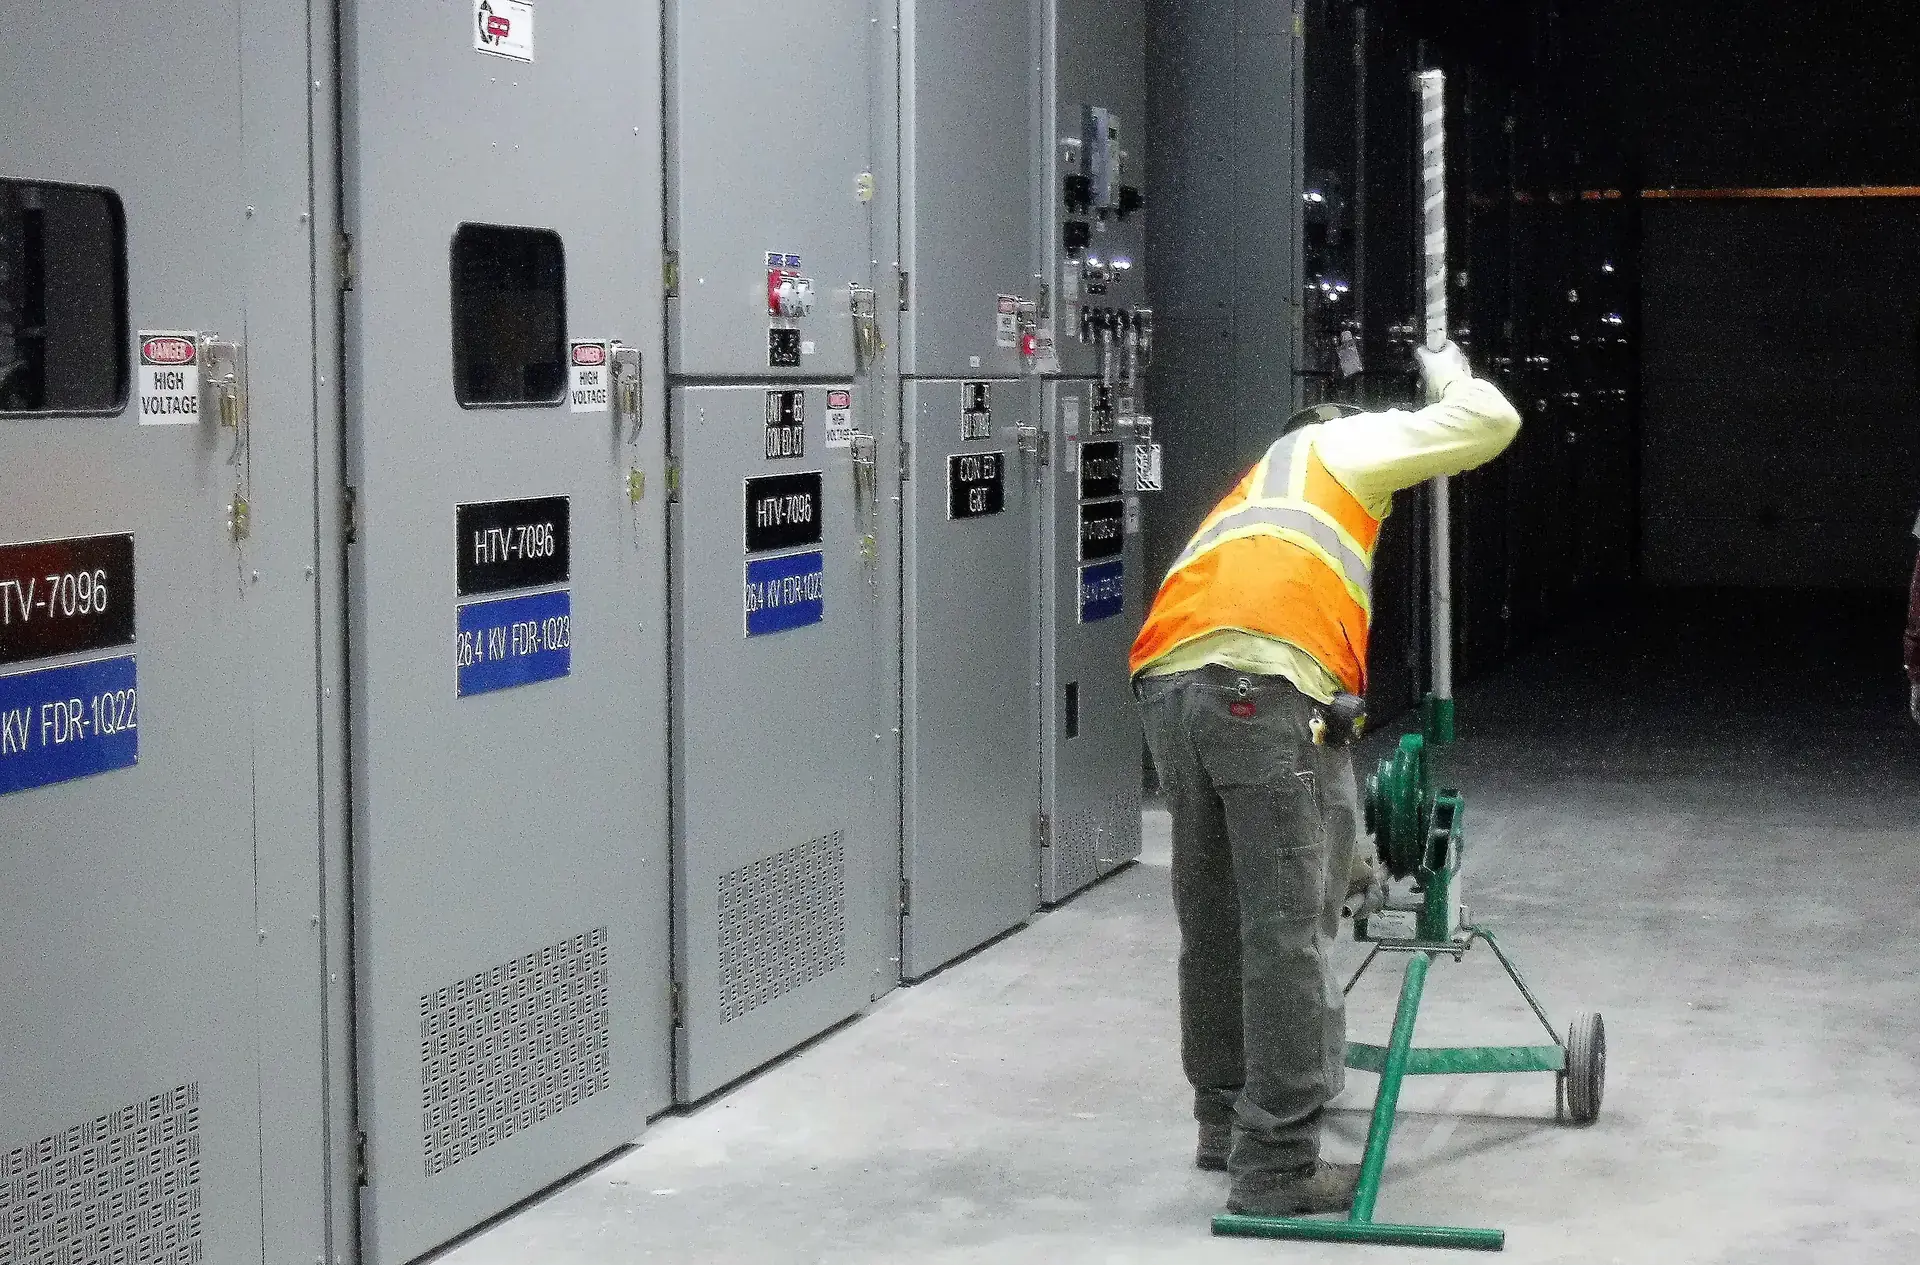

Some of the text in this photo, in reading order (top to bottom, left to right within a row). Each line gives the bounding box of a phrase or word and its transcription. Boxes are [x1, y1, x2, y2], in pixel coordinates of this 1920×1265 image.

[154, 372, 184, 390] HIGH
[579, 371, 599, 386] HIGH
[142, 396, 198, 415] VOLTAGE
[572, 389, 606, 405] VOLTAGE
[960, 455, 995, 482] CON ED
[757, 493, 812, 528] HTV-7096
[474, 522, 554, 565] HTV-7096
[767, 579, 781, 609] KV
[457, 615, 571, 668] 26.4 KV FDR-1Q23
[2, 688, 137, 754] KV FDR-1Q22
